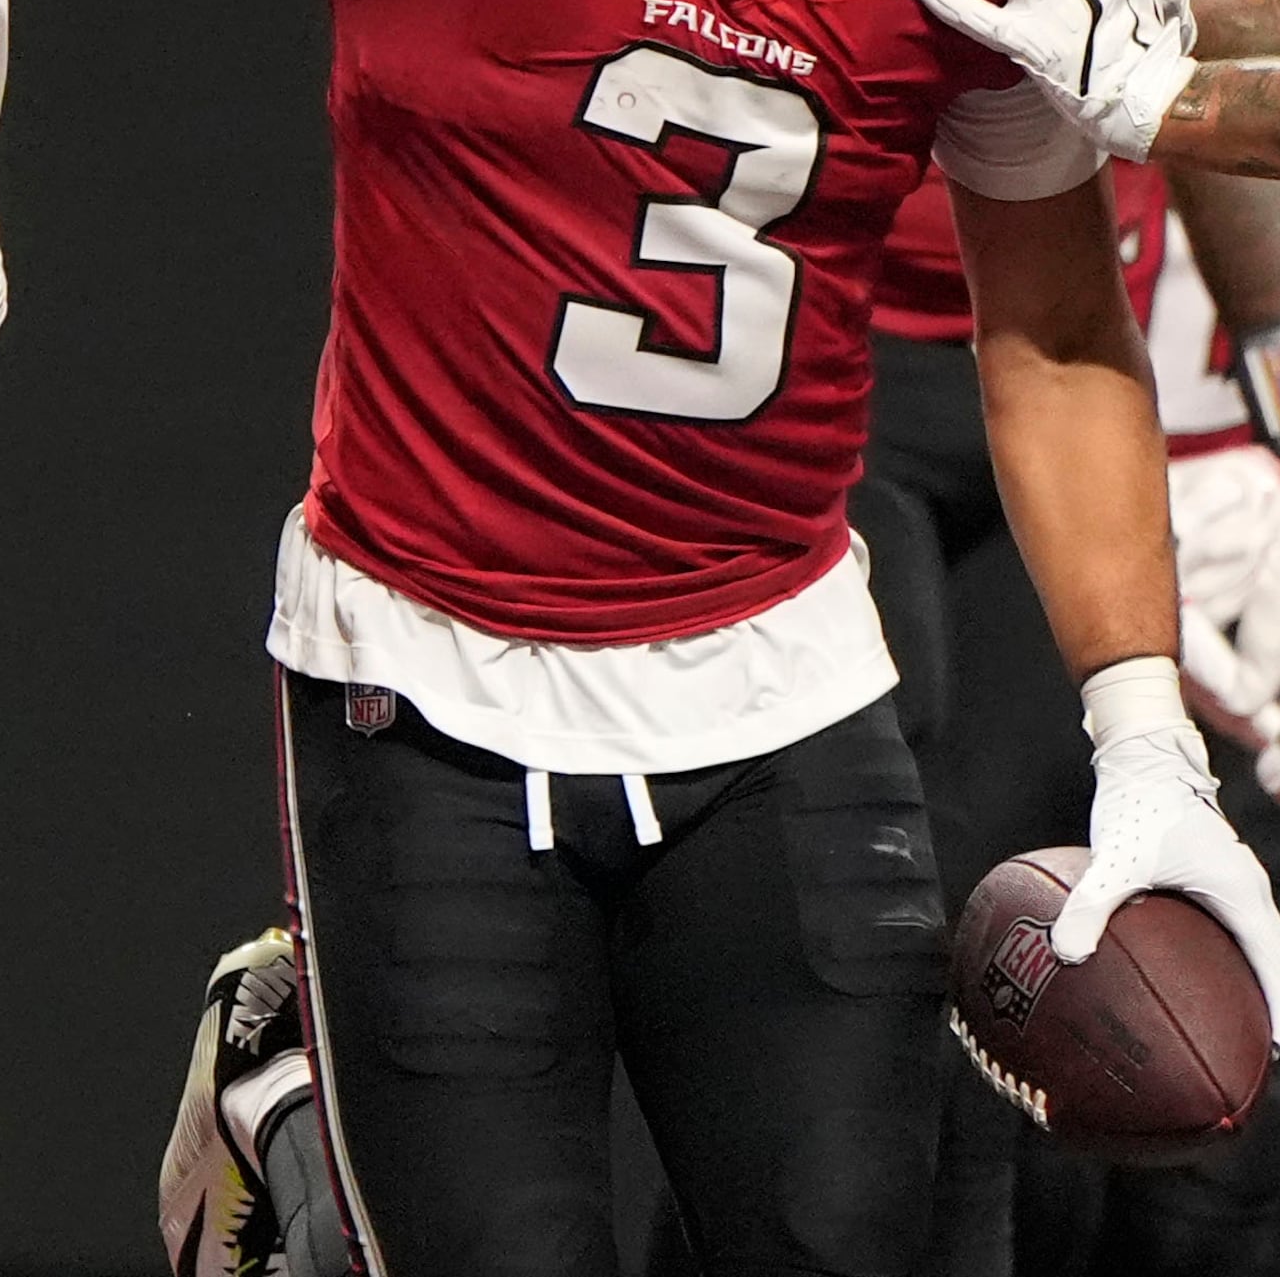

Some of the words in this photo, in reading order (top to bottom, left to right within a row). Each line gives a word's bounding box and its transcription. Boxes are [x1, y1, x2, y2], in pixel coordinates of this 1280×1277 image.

[545, 38, 828, 425] 3
[354, 699, 386, 721] NFL
[1002, 927, 1057, 993] NFL
